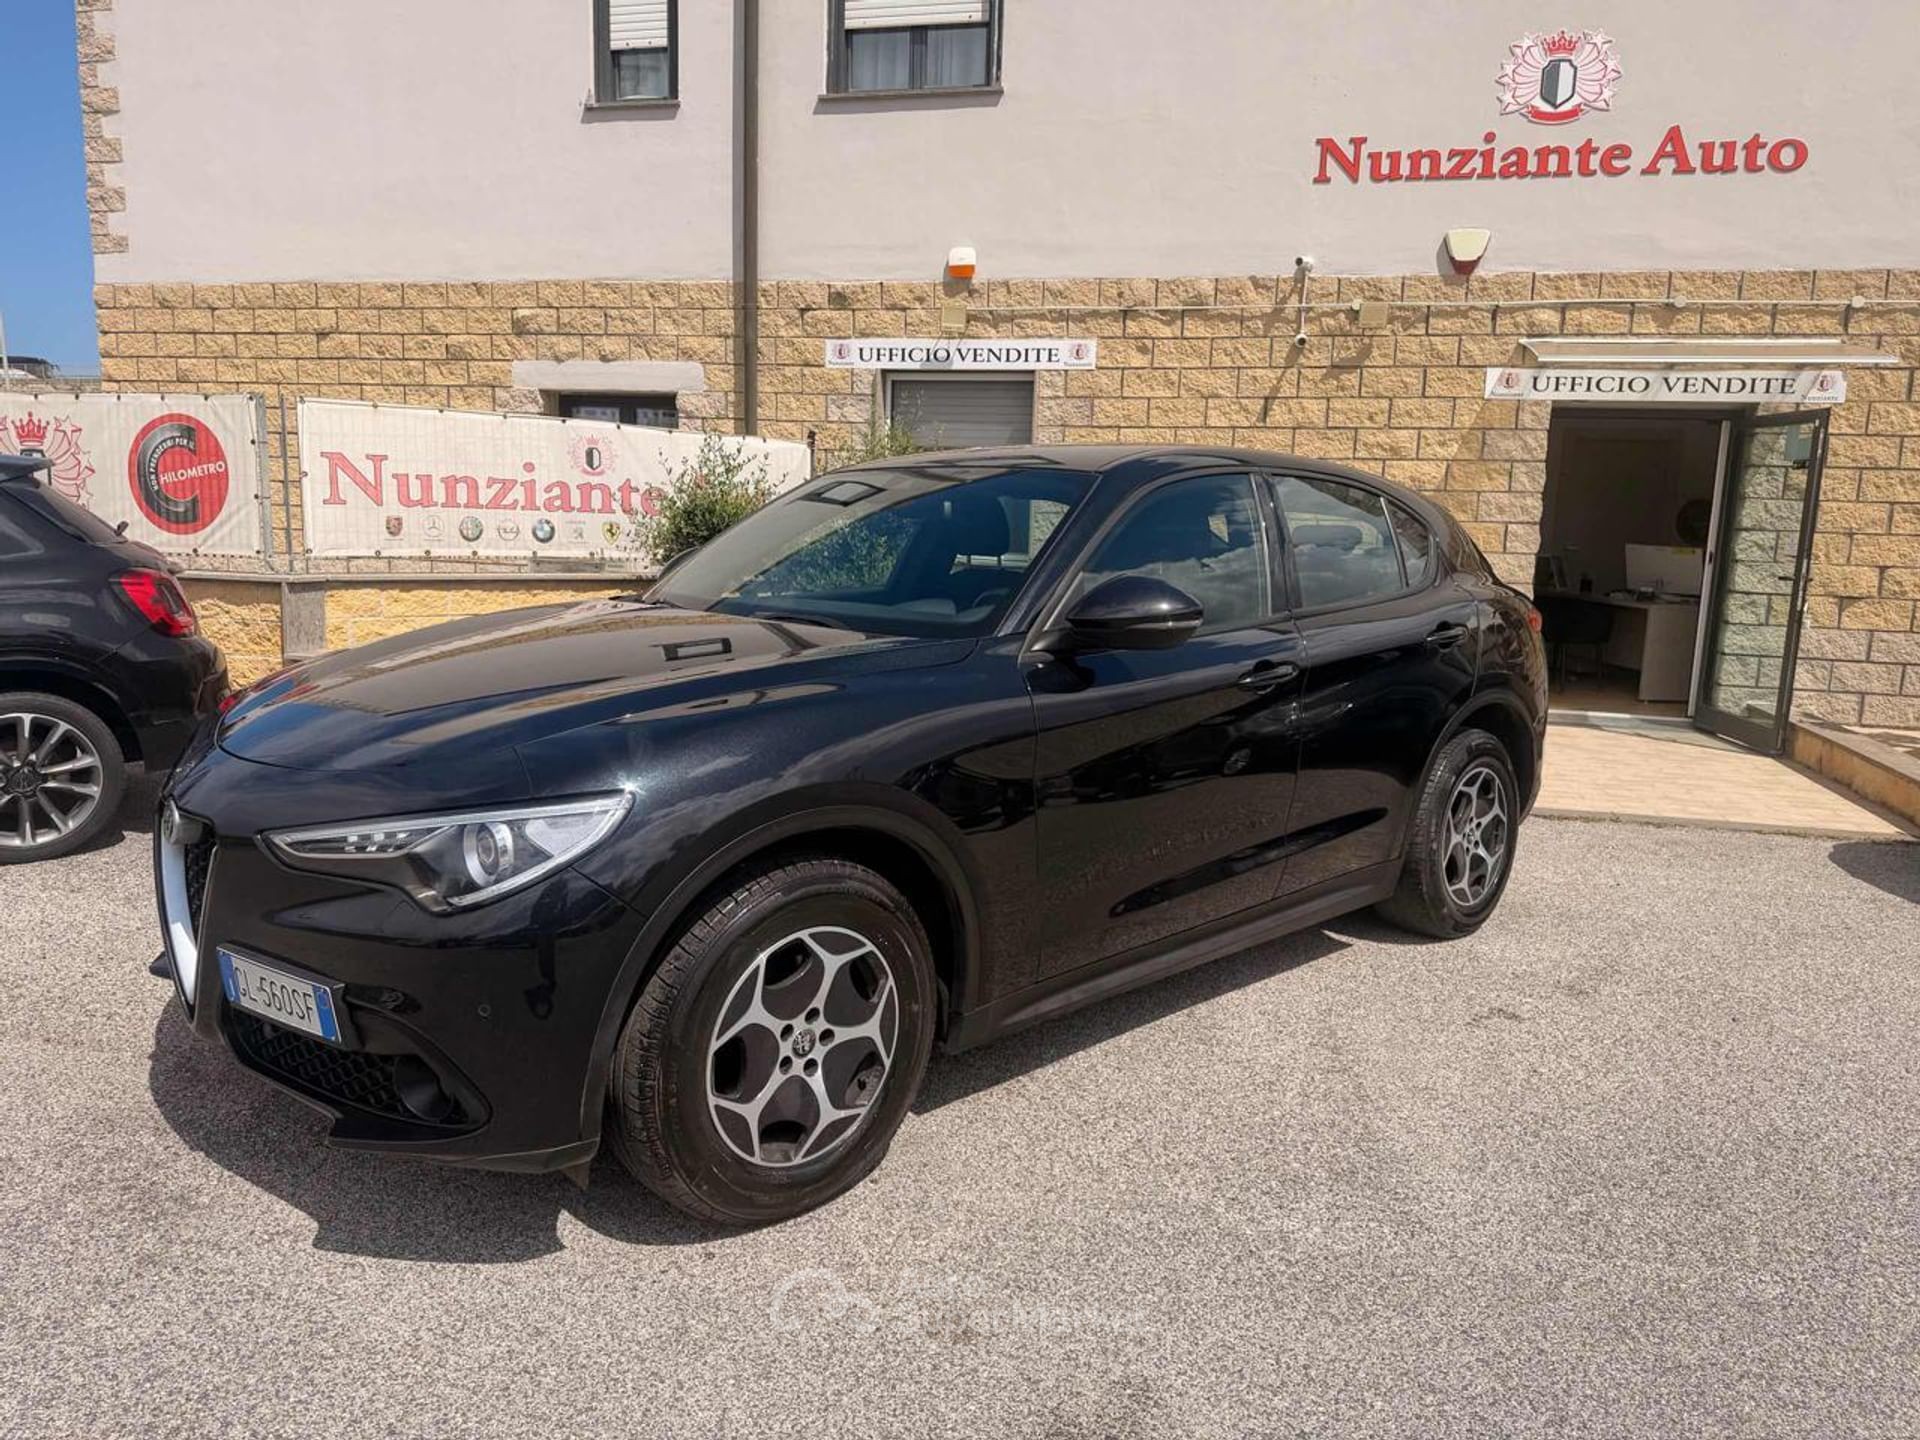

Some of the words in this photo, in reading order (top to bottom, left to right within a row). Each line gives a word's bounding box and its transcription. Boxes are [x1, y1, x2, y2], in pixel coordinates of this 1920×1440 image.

[1313, 131, 1631, 183] Nunziante
[1641, 124, 1809, 175] Auto
[858, 347, 950, 363] UFFICIO
[959, 348, 1060, 363] VENDITE
[1532, 375, 1650, 393] UFFICIO
[1662, 377, 1796, 395] VENDITE
[320, 451, 667, 518] Nunziante
